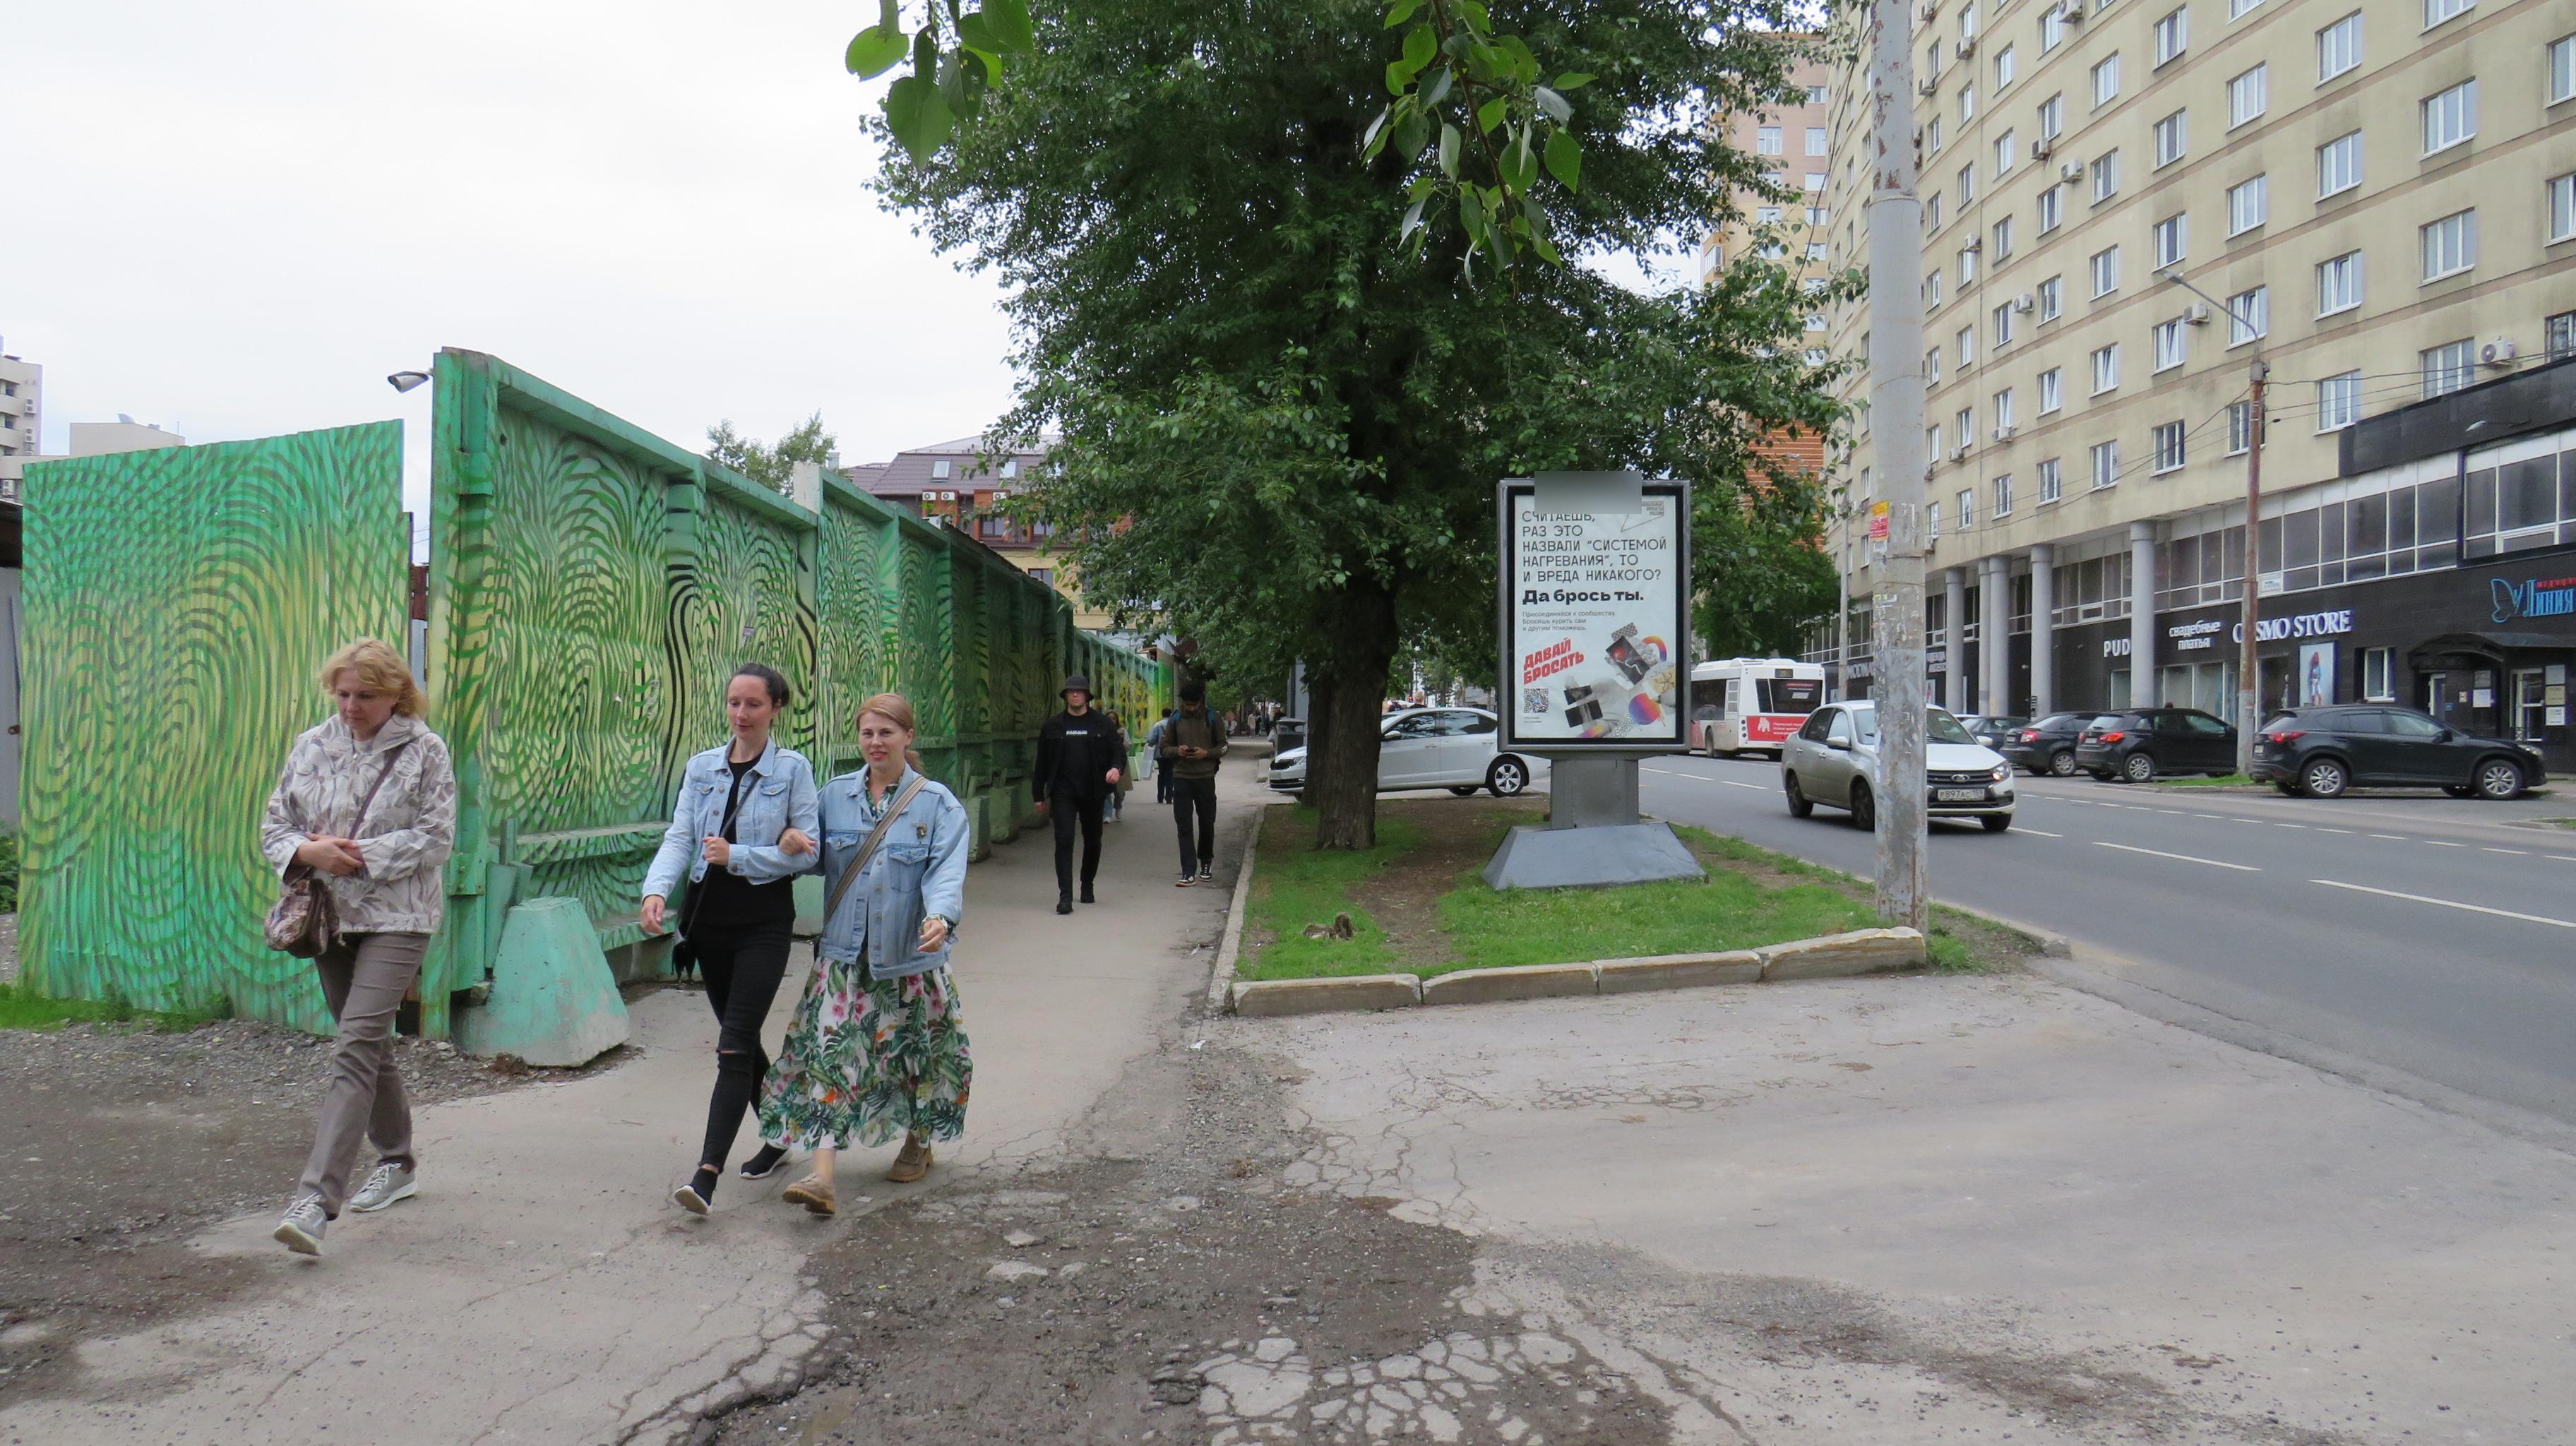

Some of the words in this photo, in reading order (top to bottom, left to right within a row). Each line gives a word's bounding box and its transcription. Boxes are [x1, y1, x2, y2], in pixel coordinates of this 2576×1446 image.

[1522, 511, 1595, 522] СЧИТАЕШЬ,
[1522, 526, 1546, 537] РАЗ
[1554, 525, 1583, 537] ЭТО
[1522, 540, 1580, 551] НАЗВАЛИ
[1619, 554, 1638, 566] ТО
[1523, 571, 1531, 582] И
[1537, 570, 1580, 583] ВРЕДА
[1586, 569, 1662, 581] НИКАКОГО?
[1522, 590, 1550, 605] Да
[1554, 590, 1611, 605] брось
[1614, 591, 1644, 601] ты.
[2522, 579, 2574, 617] Линия
[2169, 620, 2222, 638] свадебные
[2232, 618, 2291, 643] CSMO
[2293, 610, 2352, 637] STORE
[2104, 638, 2131, 657] PUD
[2178, 637, 2211, 650] платья
[1524, 637, 1571, 671] ДАВАЙ
[1524, 651, 1585, 685] БРОСАТЬ
